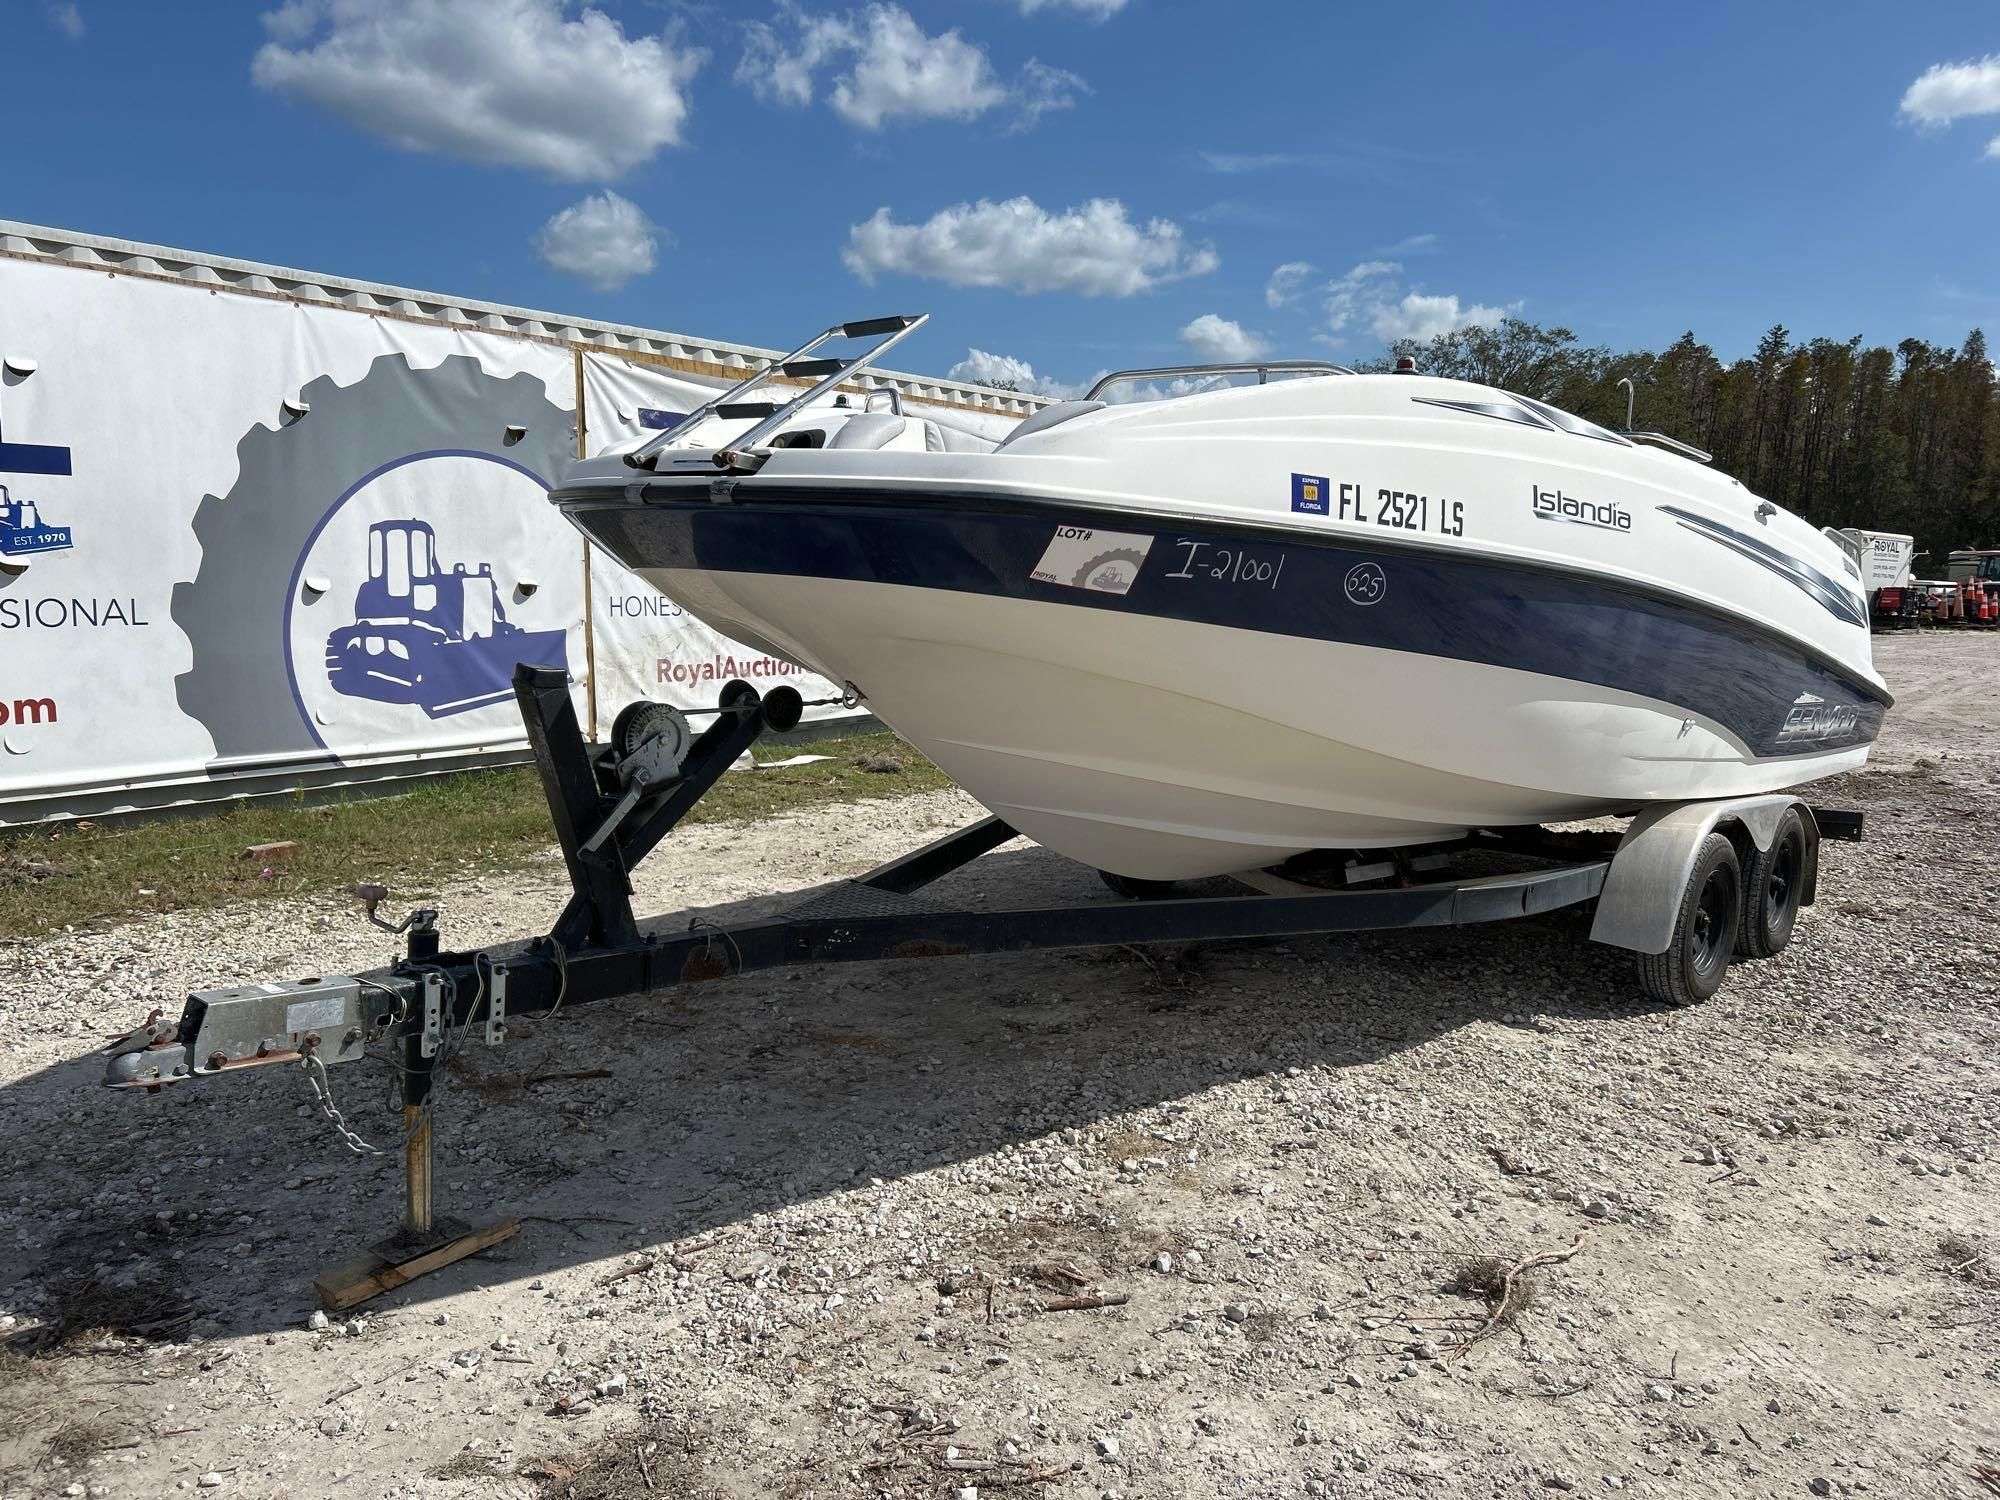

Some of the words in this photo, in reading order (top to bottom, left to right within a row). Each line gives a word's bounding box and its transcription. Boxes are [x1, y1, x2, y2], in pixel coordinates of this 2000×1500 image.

[1339, 484, 1367, 522] FL
[1377, 488, 1427, 531] 2521
[1441, 498, 1463, 537] LS
[1533, 484, 1631, 530] Islandia
[14, 535, 36, 546] EST.
[38, 532, 66, 543] 1970
[1056, 527, 1093, 541] LOT#
[1874, 540, 1900, 554] ROYAL
[1347, 564, 1384, 597] 625
[0, 598, 149, 629] SIONAL
[610, 596, 690, 617] HONES
